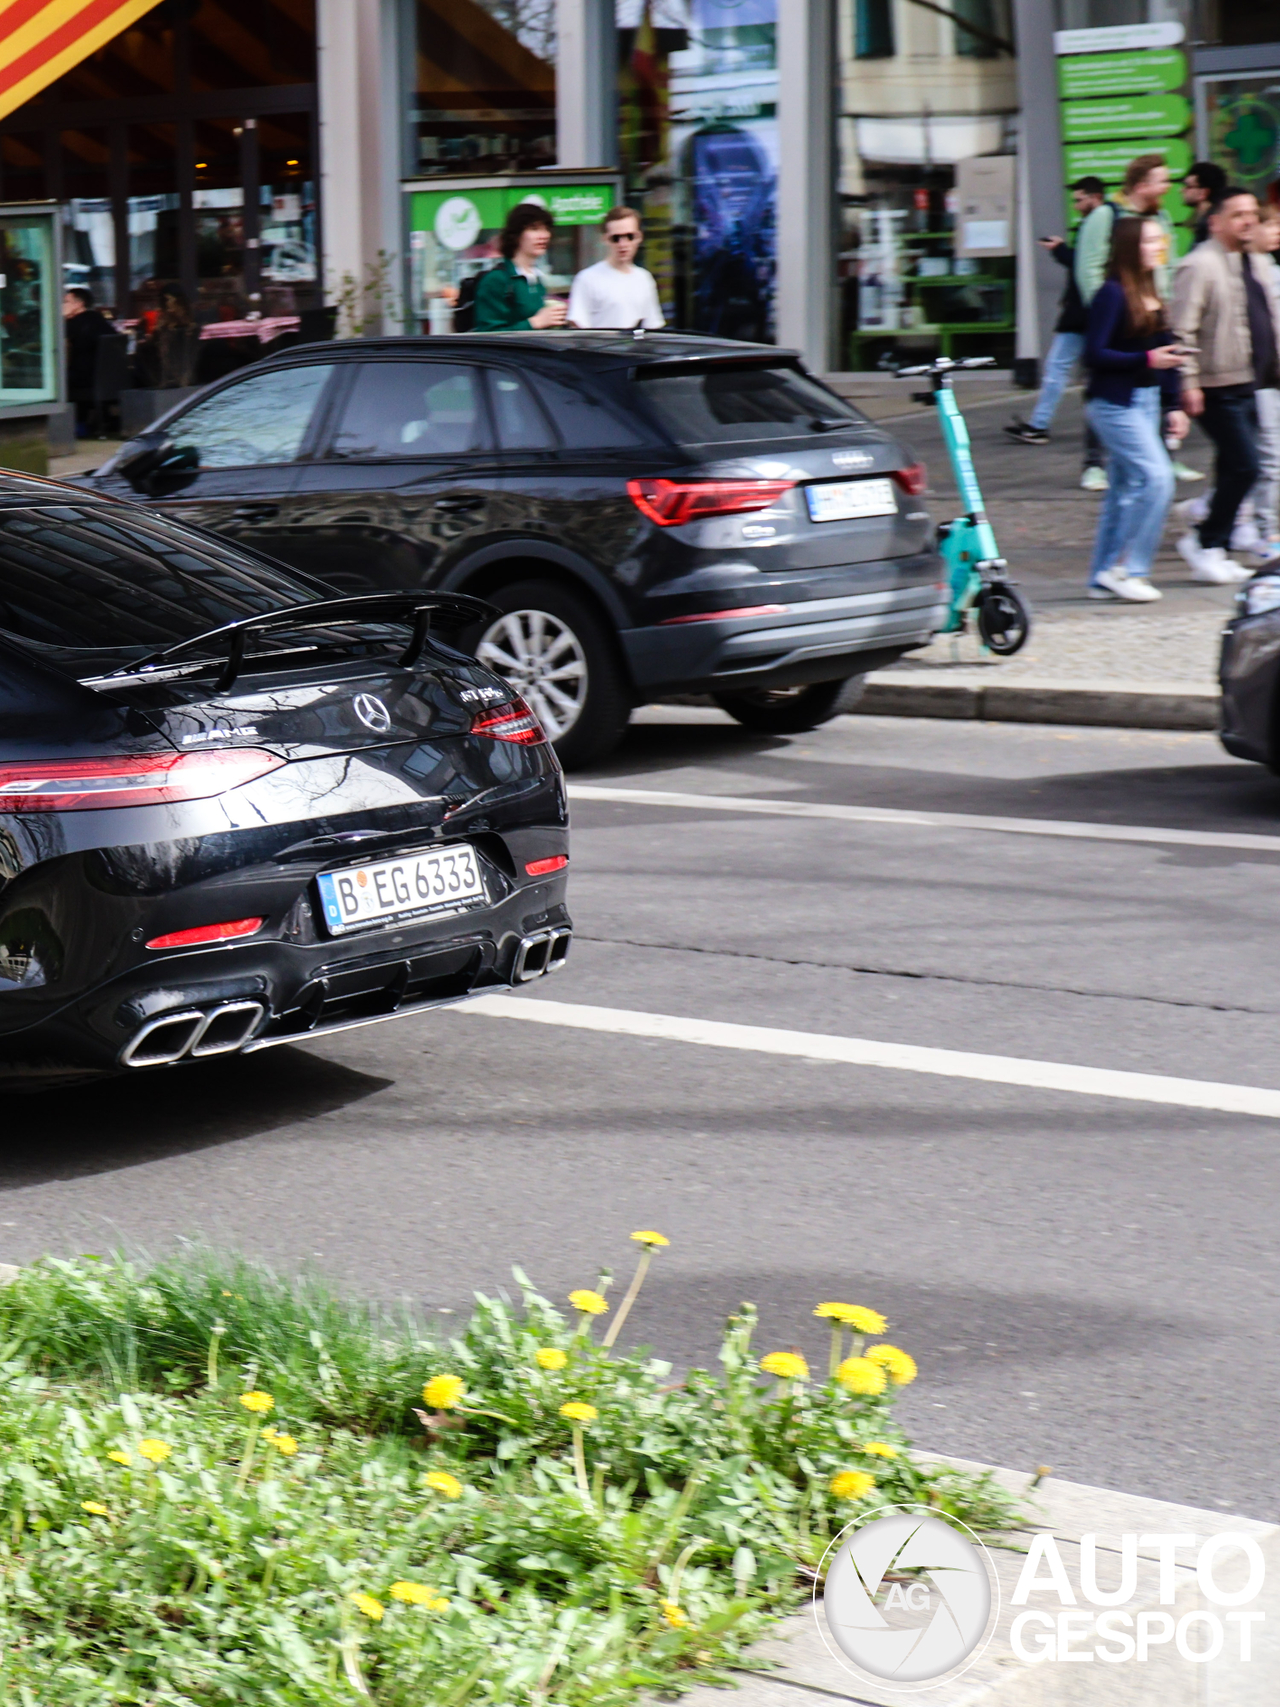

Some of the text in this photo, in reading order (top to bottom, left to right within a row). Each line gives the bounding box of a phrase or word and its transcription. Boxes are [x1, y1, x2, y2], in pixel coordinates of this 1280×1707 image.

[206, 726, 259, 740] AMG
[338, 877, 359, 916] B
[372, 866, 412, 908] EG
[415, 852, 476, 898] 6333
